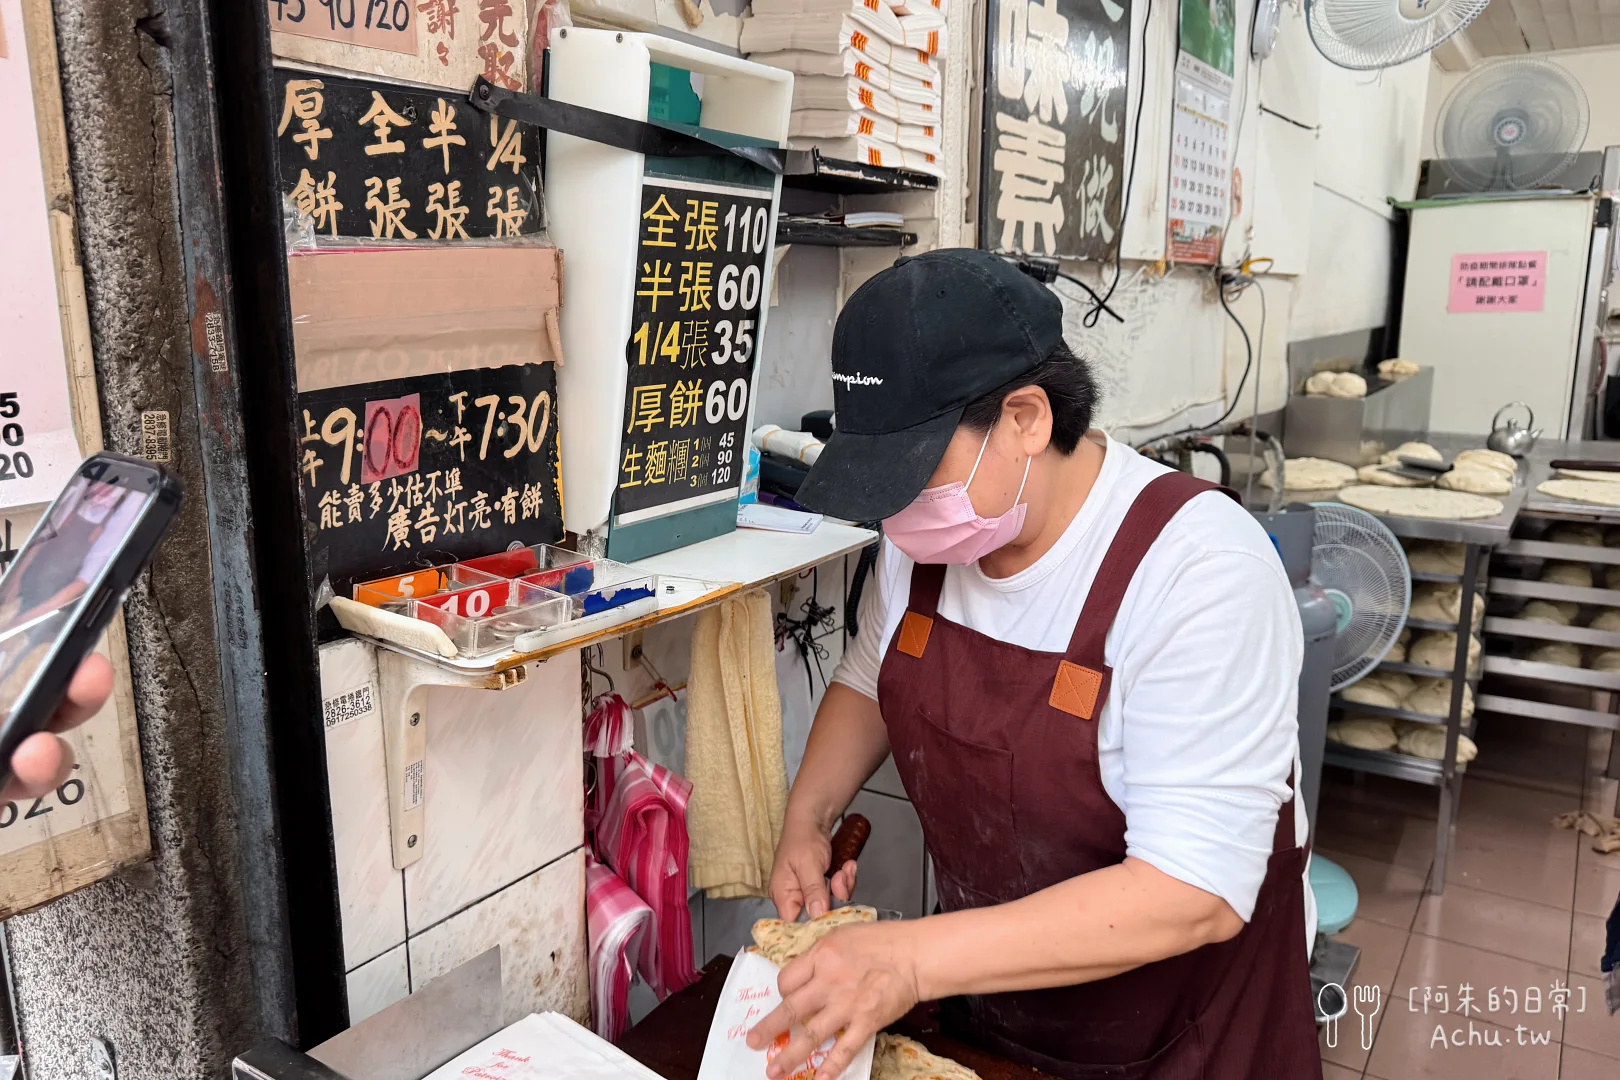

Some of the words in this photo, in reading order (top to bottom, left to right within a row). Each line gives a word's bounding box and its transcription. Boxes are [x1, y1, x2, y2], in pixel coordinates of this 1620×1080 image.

[358, 91, 418, 240] 全張
[423, 98, 472, 240] 半張
[642, 193, 719, 253] 全張
[723, 203, 769, 255] 110
[636, 259, 714, 313] 半張
[717, 263, 762, 311] 60
[633, 319, 710, 370] 1/4張
[711, 319, 756, 366] 35
[474, 391, 549, 461] 7:30
[626, 378, 704, 436] 厚餅
[705, 377, 748, 425] 60
[717, 449, 733, 466] 90
[719, 432, 735, 449] 45
[711, 466, 731, 486] 120
[397, 577, 415, 599] 5
[440, 590, 490, 617] 10
